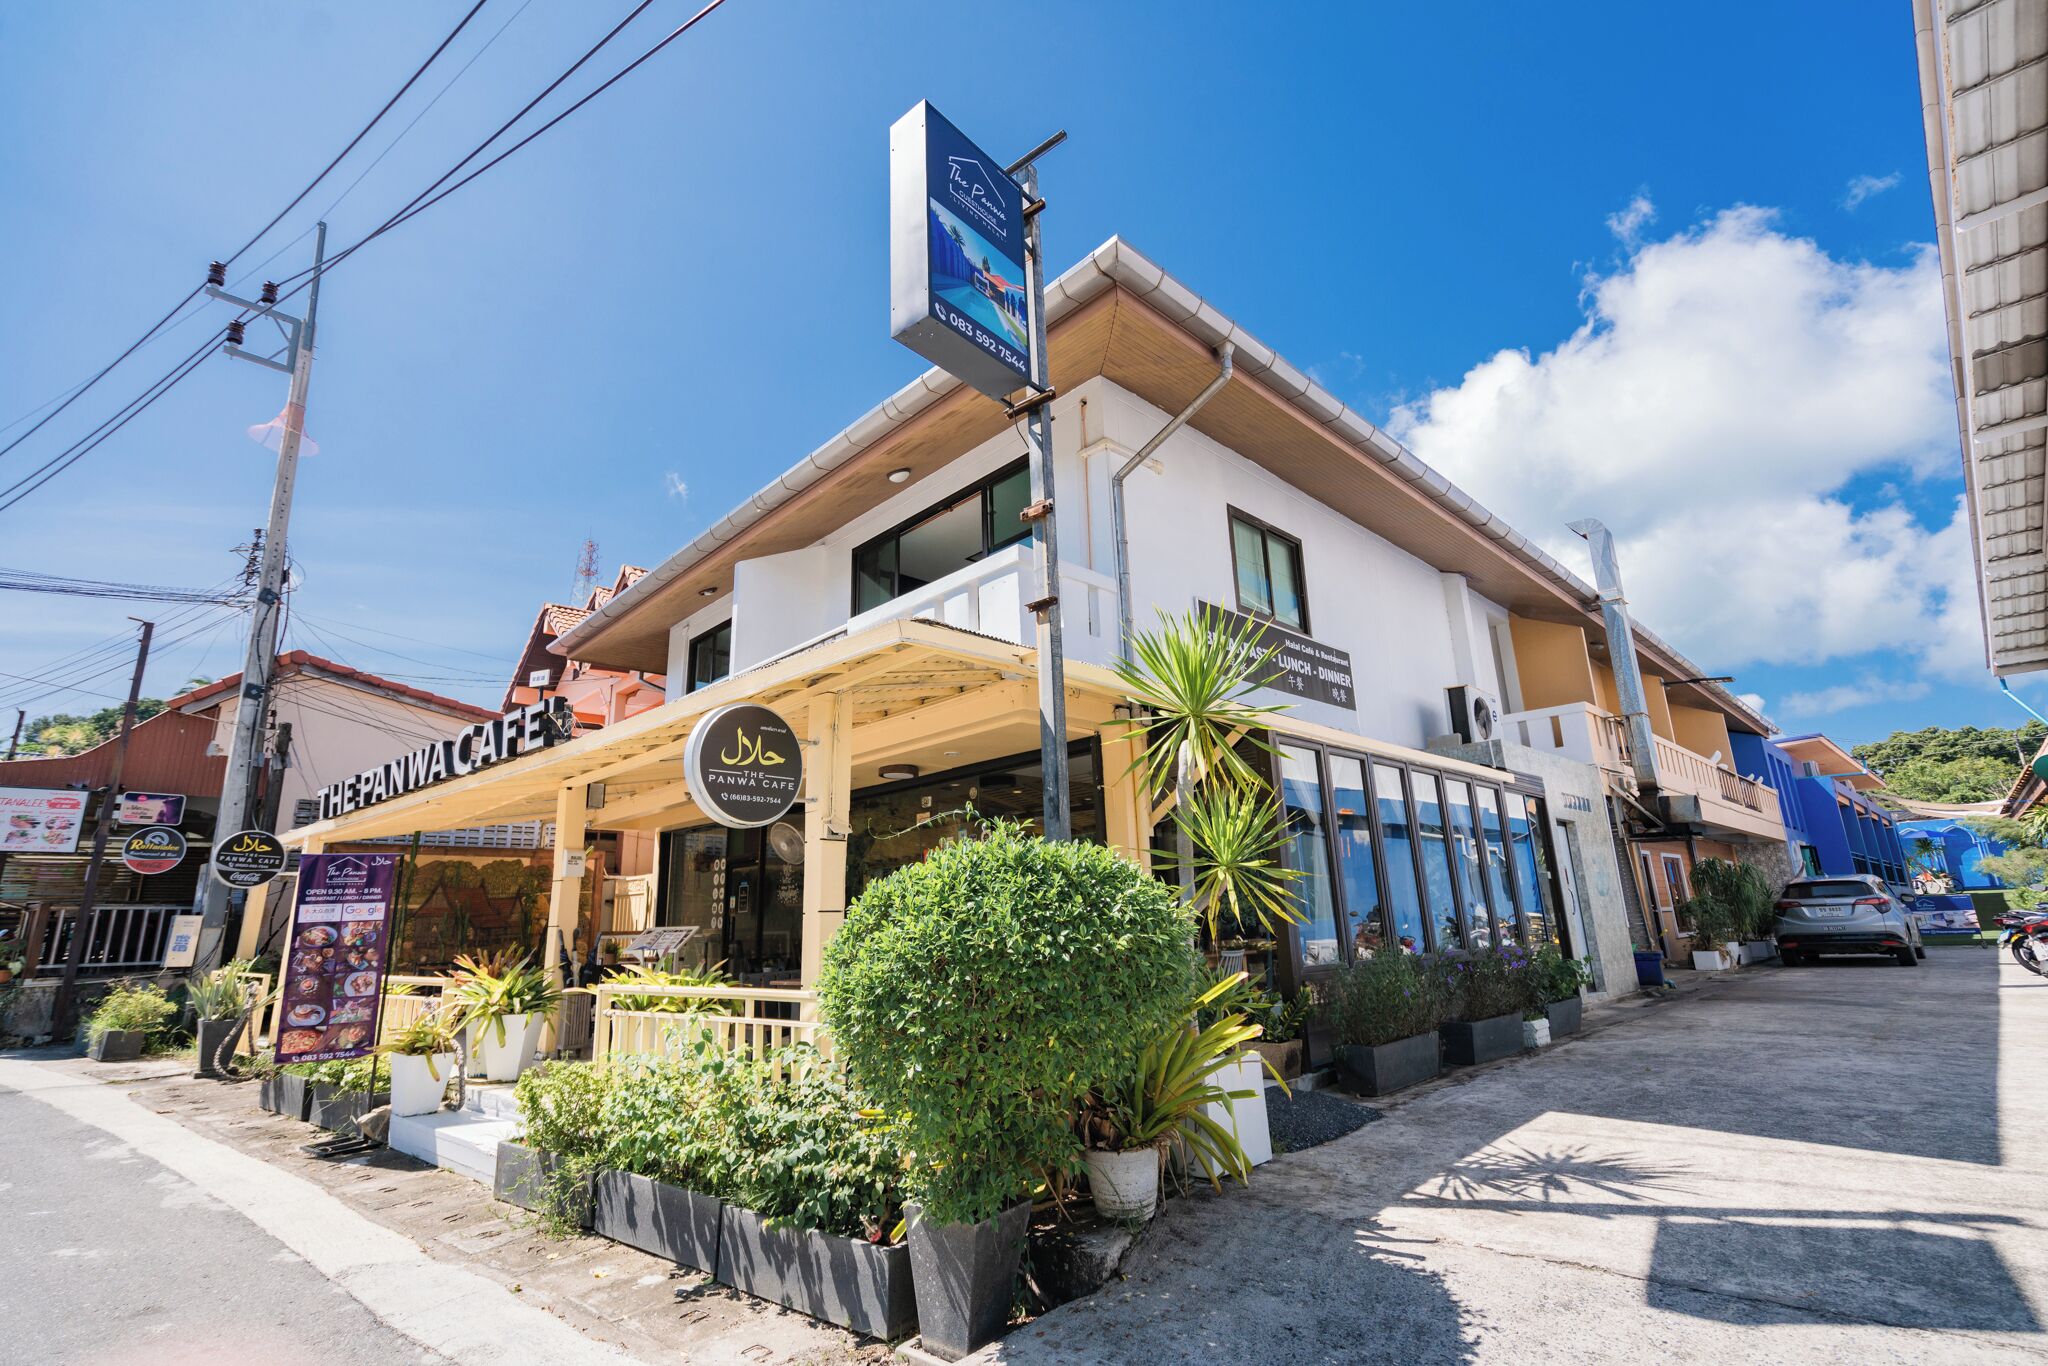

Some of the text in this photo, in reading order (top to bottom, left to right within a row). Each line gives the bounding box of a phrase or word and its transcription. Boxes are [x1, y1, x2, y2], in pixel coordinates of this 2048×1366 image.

[948, 162, 969, 187] The
[971, 183, 1006, 221] Panwa
[959, 190, 997, 225] GUESTHOUSE
[949, 312, 1026, 372] 083 592 7544
[1285, 638, 1300, 651] Halal
[1315, 650, 1320, 658] &
[1320, 650, 1349, 667] Restaurant
[1278, 653, 1312, 676] LUNCH
[1318, 666, 1352, 688] DINNER
[1288, 674, 1305, 691] 午餐
[721, 727, 786, 766] حلال
[317, 774, 357, 820] THE
[359, 740, 448, 808] PANWA
[708, 774, 795, 791] PANWA CAFE
[743, 771, 765, 779] THE
[729, 794, 781, 805] (66)83-592-7544
[232, 835, 273, 852] حلال
[219, 855, 253, 863] PANWA
[371, 856, 392, 866] حلال
[345, 905, 383, 915] Google
